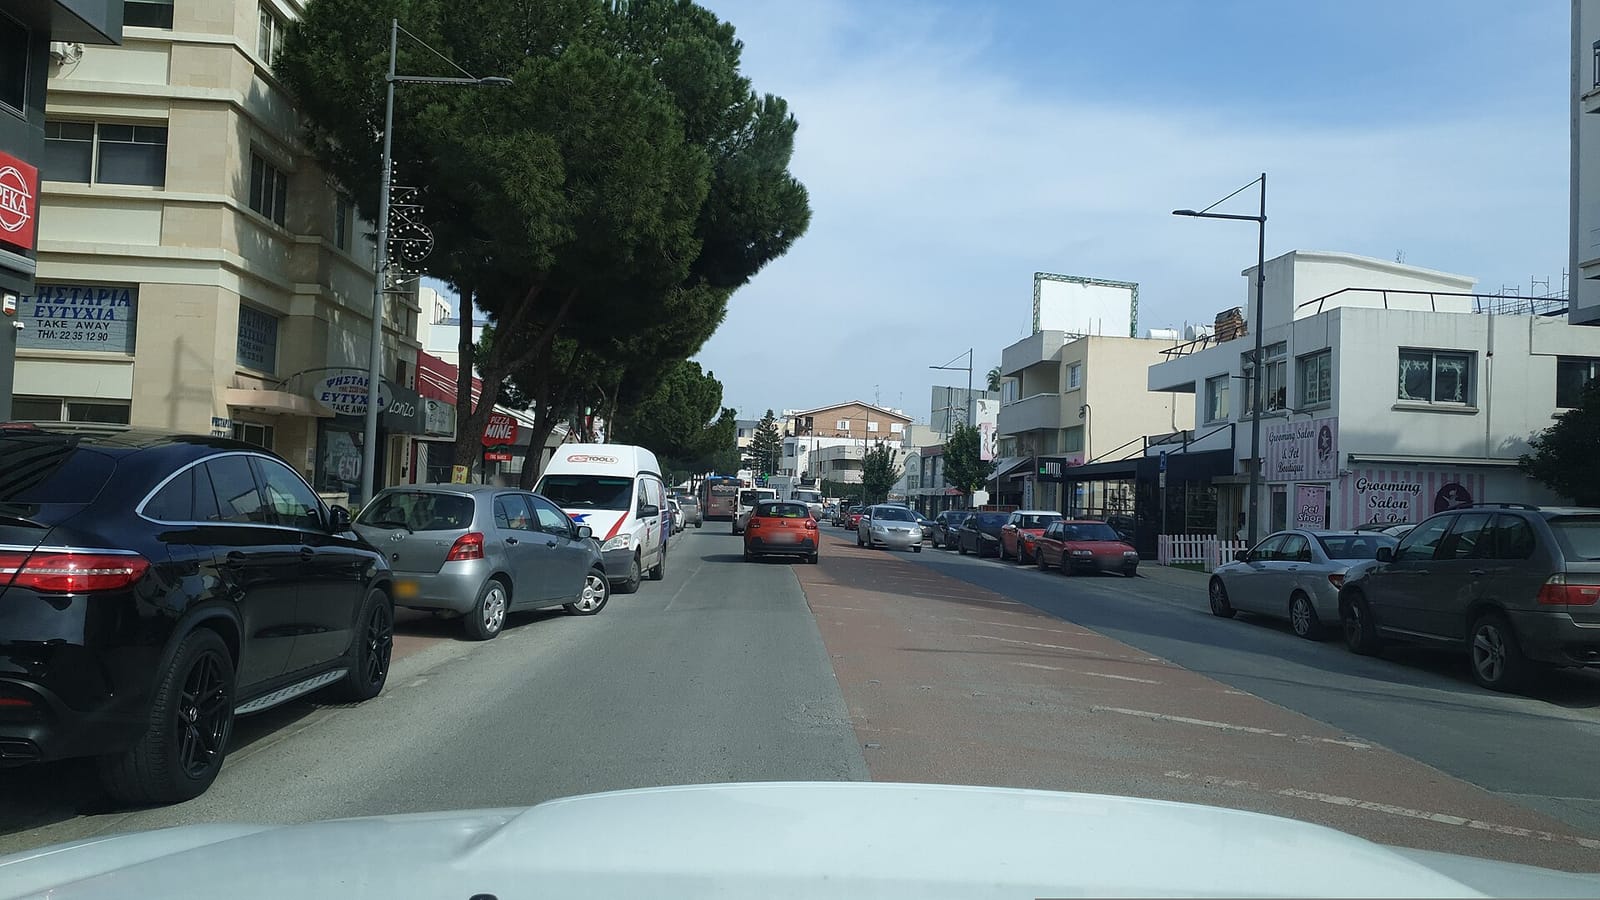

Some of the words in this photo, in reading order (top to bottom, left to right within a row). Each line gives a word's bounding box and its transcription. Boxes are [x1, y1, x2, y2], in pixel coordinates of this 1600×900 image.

[33, 306, 114, 321] ΕΥΤΥΧΙΑ
[36, 320, 68, 329] TAKE
[75, 321, 110, 331] AWAY
[59, 331, 70, 340] 22
[71, 331, 83, 341] 35
[86, 332, 96, 341] 12
[97, 332, 108, 342] 90
[320, 392, 384, 406] ΕΥΤΥΧΑ
[332, 403, 350, 413] TAKE
[352, 405, 368, 414] AWA
[490, 416, 510, 425] PIZZA
[484, 424, 514, 439] MINE
[1268, 430, 1296, 446] Grooming
[1296, 427, 1315, 440] Salon
[1289, 446, 1300, 459] Pet
[1277, 461, 1305, 475] Boutique
[1356, 477, 1421, 496] Grooming
[1302, 504, 1320, 513] Pet
[1368, 495, 1409, 509] Salon
[1297, 513, 1323, 525] Shop
